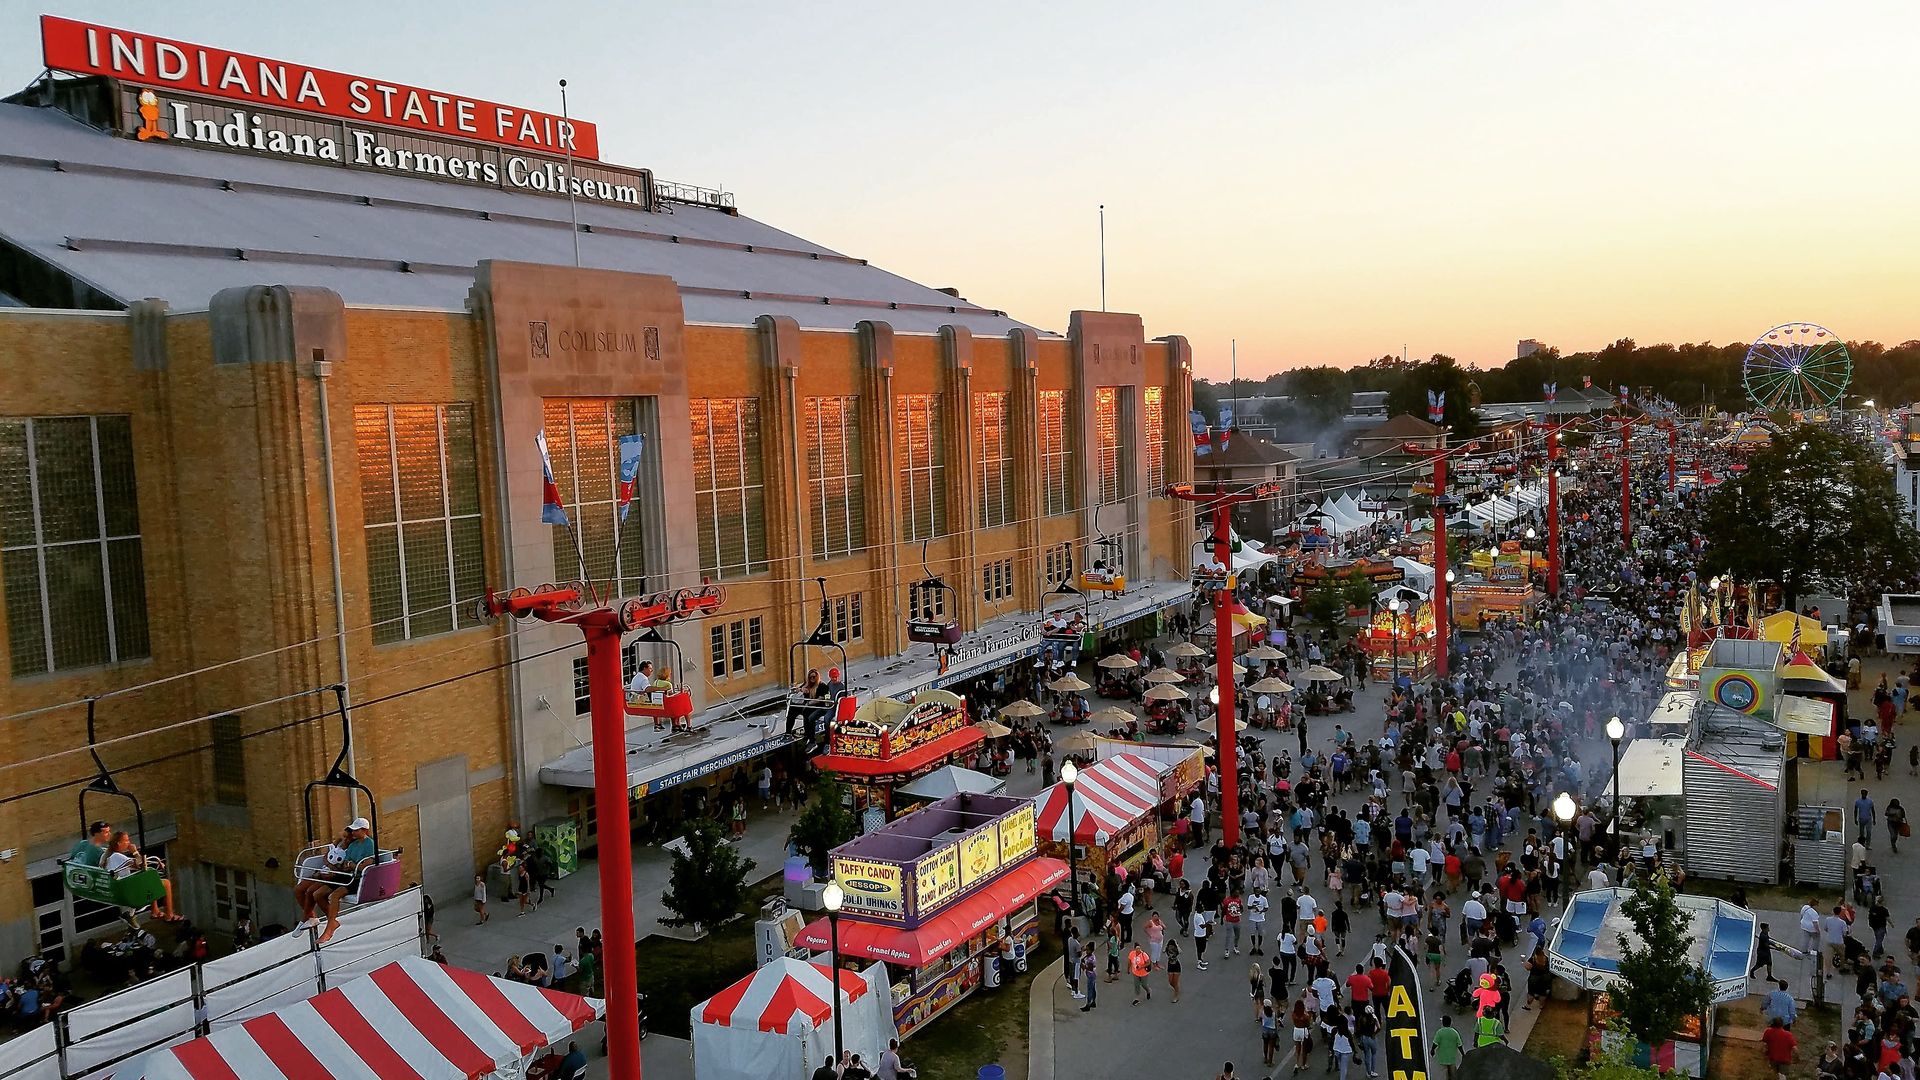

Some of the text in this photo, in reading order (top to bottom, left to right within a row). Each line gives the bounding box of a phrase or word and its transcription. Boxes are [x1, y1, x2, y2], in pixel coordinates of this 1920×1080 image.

[86, 28, 577, 151] INDIANA STATE FAIR
[170, 102, 640, 205] Indiana Farmers Coliseum
[558, 330, 637, 353] COLISEUM
[947, 648, 982, 667] Indiana
[985, 634, 1022, 654] Farmers
[1022, 624, 1042, 641] Coli
[659, 774, 682, 789] STATE
[682, 768, 699, 781] FAIR
[700, 751, 747, 774] MERCHANDISE
[747, 744, 764, 757] SOLD
[1003, 835, 1033, 860] POPCORN
[840, 862, 895, 881] TAFFY CANDY
[919, 858, 939, 877] COTTON
[939, 850, 955, 867] CANDY
[846, 880, 889, 892] JESSOP'S
[921, 877, 956, 906] CANDY APPLES
[866, 896, 898, 910] DRINKS
[806, 935, 828, 945] Popcorn
[927, 941, 943, 956] Caramel
[866, 945, 911, 959] Caramel Apples
[1550, 957, 1565, 966] Free
[1550, 963, 1583, 978] Engraving
